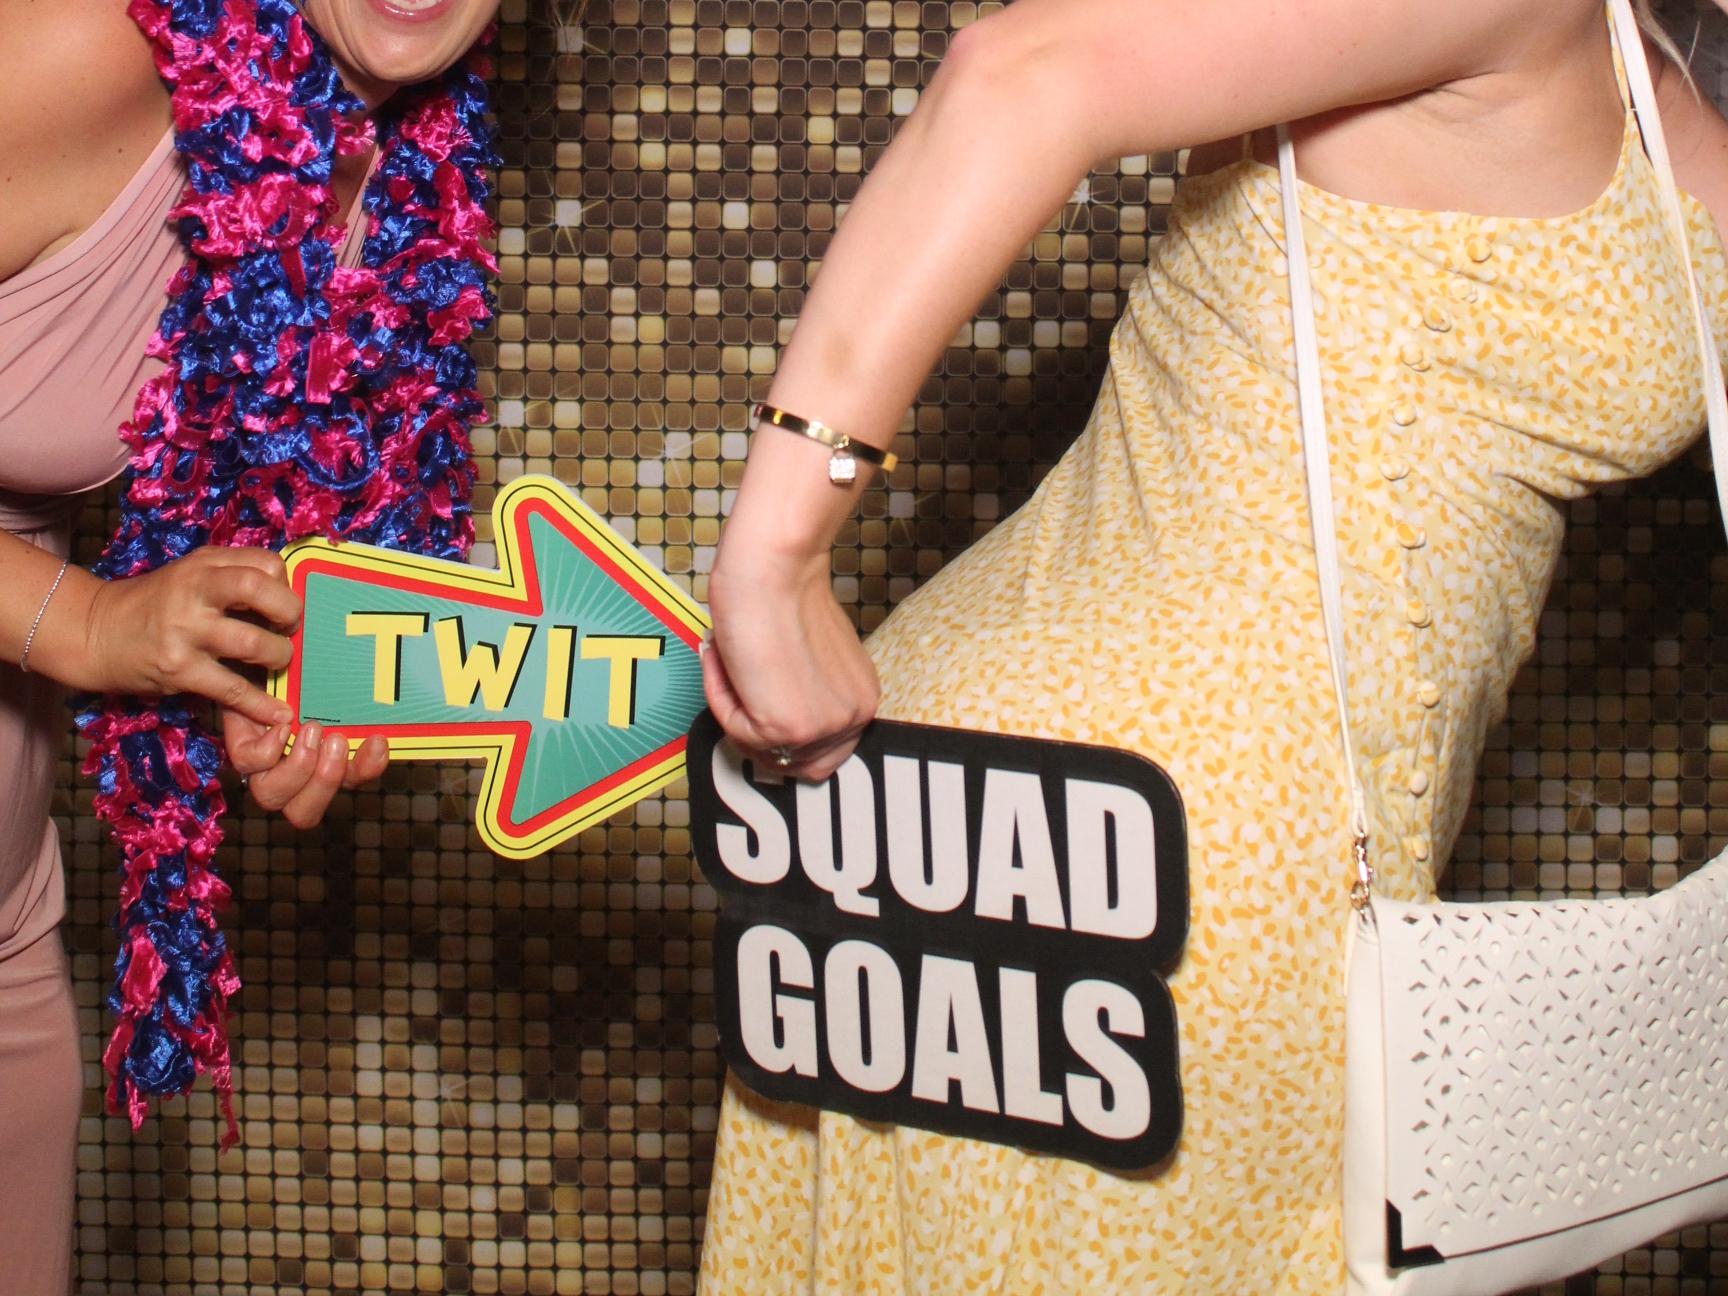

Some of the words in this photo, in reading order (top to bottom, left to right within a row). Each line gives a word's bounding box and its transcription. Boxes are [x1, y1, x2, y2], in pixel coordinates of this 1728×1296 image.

[346, 610, 666, 729] TWIT
[711, 740, 1158, 941] SQUAD
[737, 924, 1151, 1140] GOALS
